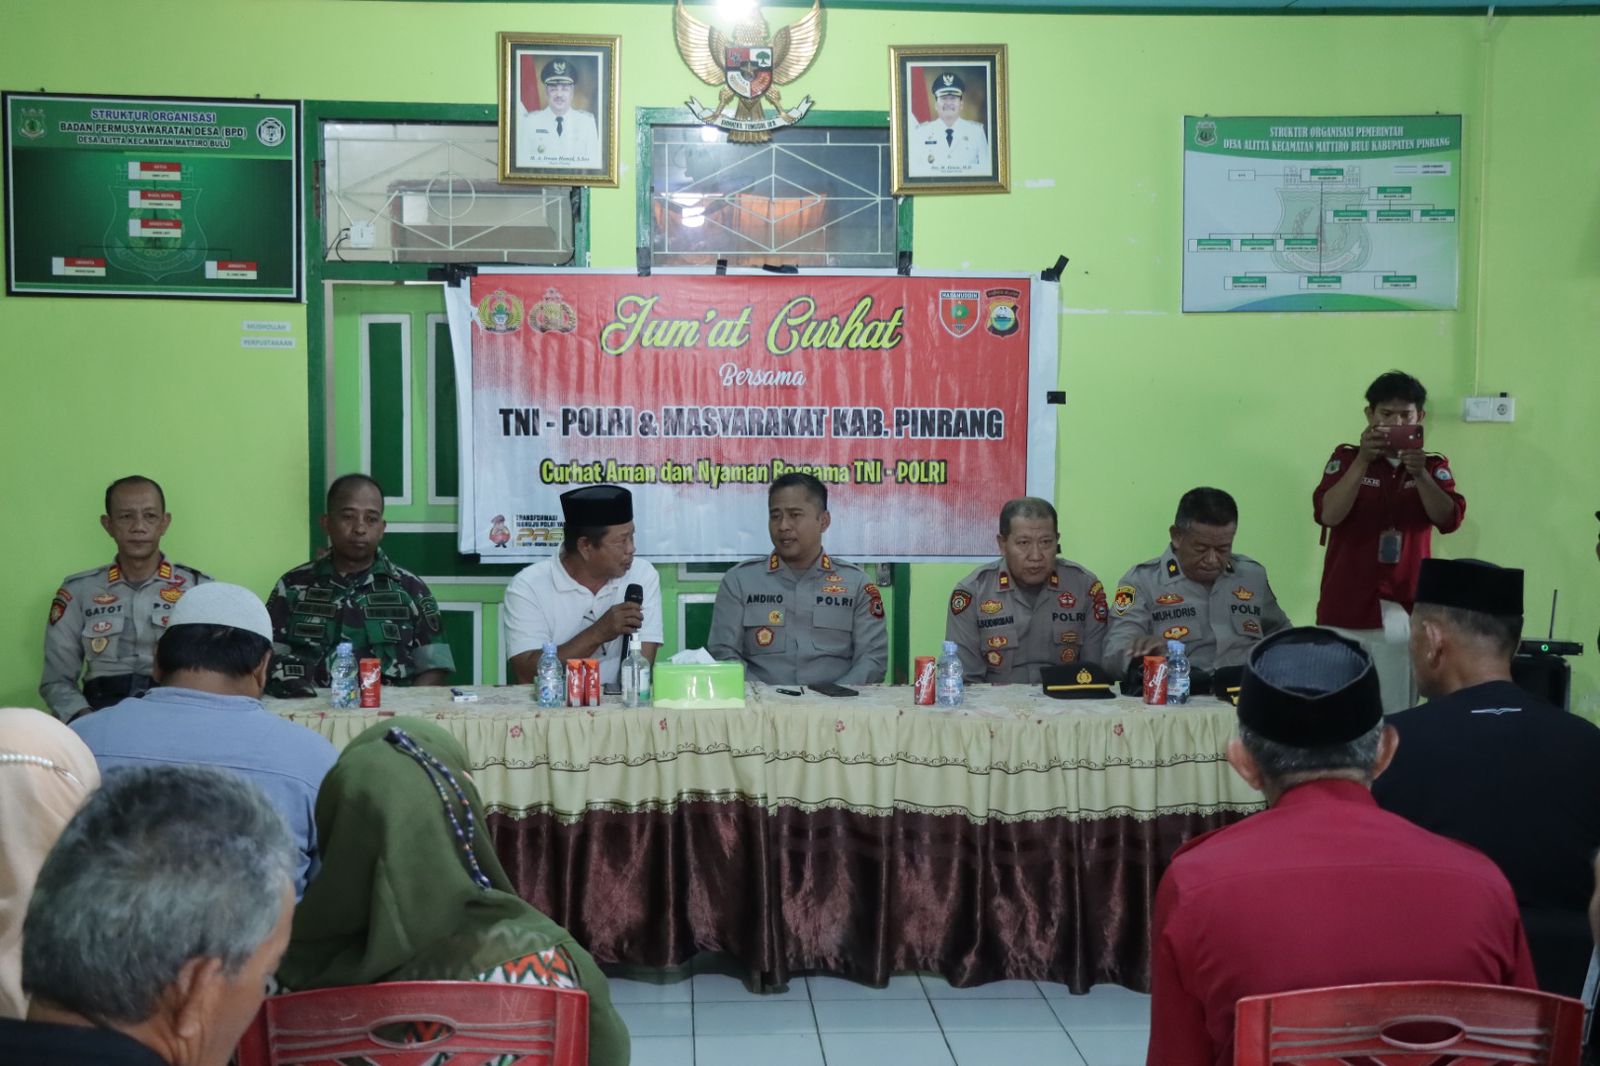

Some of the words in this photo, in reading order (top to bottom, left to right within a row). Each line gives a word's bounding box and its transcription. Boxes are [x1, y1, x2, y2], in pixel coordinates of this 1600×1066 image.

[91, 109, 149, 120] STRUKTUR
[152, 112, 216, 122] ORGANISASI
[59, 122, 93, 132] BADAN
[95, 123, 192, 135] PERMUSYAWARATAN
[194, 127, 220, 136] DESA
[222, 127, 247, 139] (BPD)
[78, 135, 98, 144] DESA
[100, 136, 126, 145] ALITTA
[127, 137, 174, 146] KECAMATAN
[175, 139, 208, 147] MATTIRO
[209, 140, 230, 148] BULU
[601, 295, 752, 355] Jum'at
[766, 295, 904, 355] Curhat
[718, 362, 806, 386] Bersama
[499, 407, 540, 437] TNI
[561, 406, 634, 438] POLRI
[638, 410, 658, 438] &
[662, 406, 826, 438] MASYARAKAT
[832, 407, 889, 438] KAB.
[895, 408, 1004, 440] PINRANG
[541, 459, 602, 483] Curhat
[604, 459, 657, 483] Aman
[660, 459, 694, 483] dan
[697, 459, 769, 489] Nyaman
[853, 460, 882, 484] TNI
[896, 460, 948, 484] POLRI
[746, 594, 783, 604] ANDIKO
[816, 596, 853, 607] POLRI
[84, 605, 123, 617] GATOT
[1052, 612, 1086, 622] POLRI
